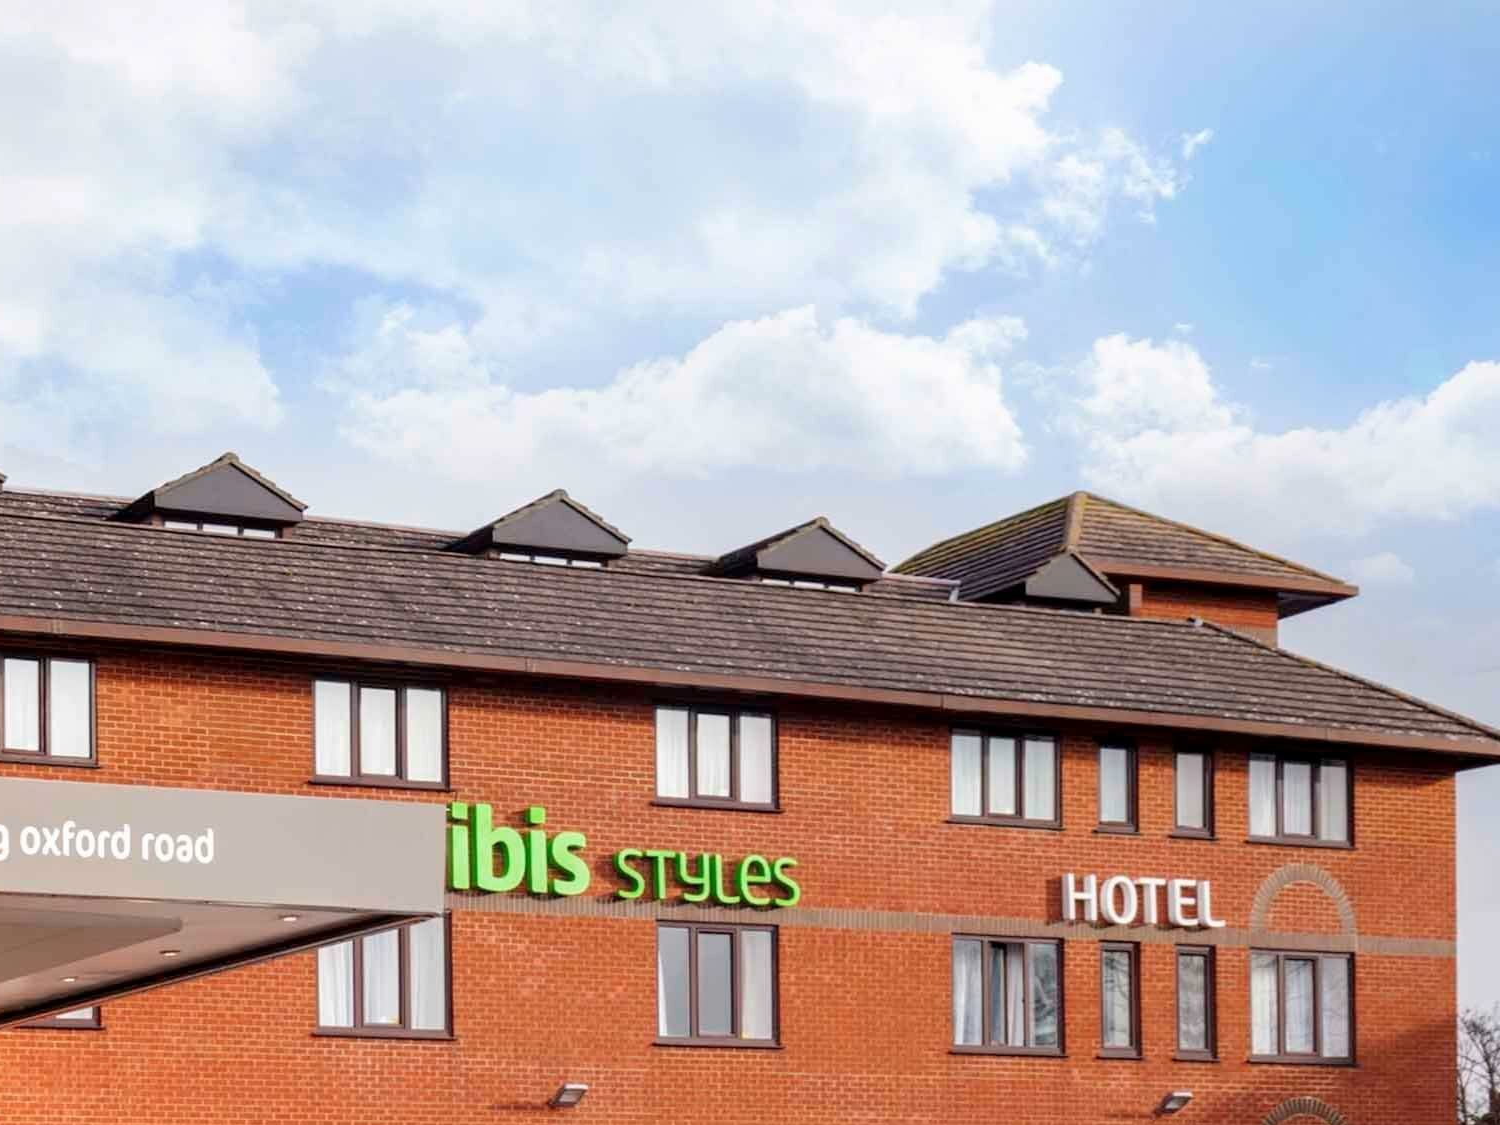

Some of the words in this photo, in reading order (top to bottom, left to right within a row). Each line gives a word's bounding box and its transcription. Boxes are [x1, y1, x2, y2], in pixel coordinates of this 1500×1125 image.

[19, 820, 132, 860] oxford
[141, 827, 215, 864] road
[448, 801, 591, 896] ibis
[1062, 873, 1226, 928] HOTEL
